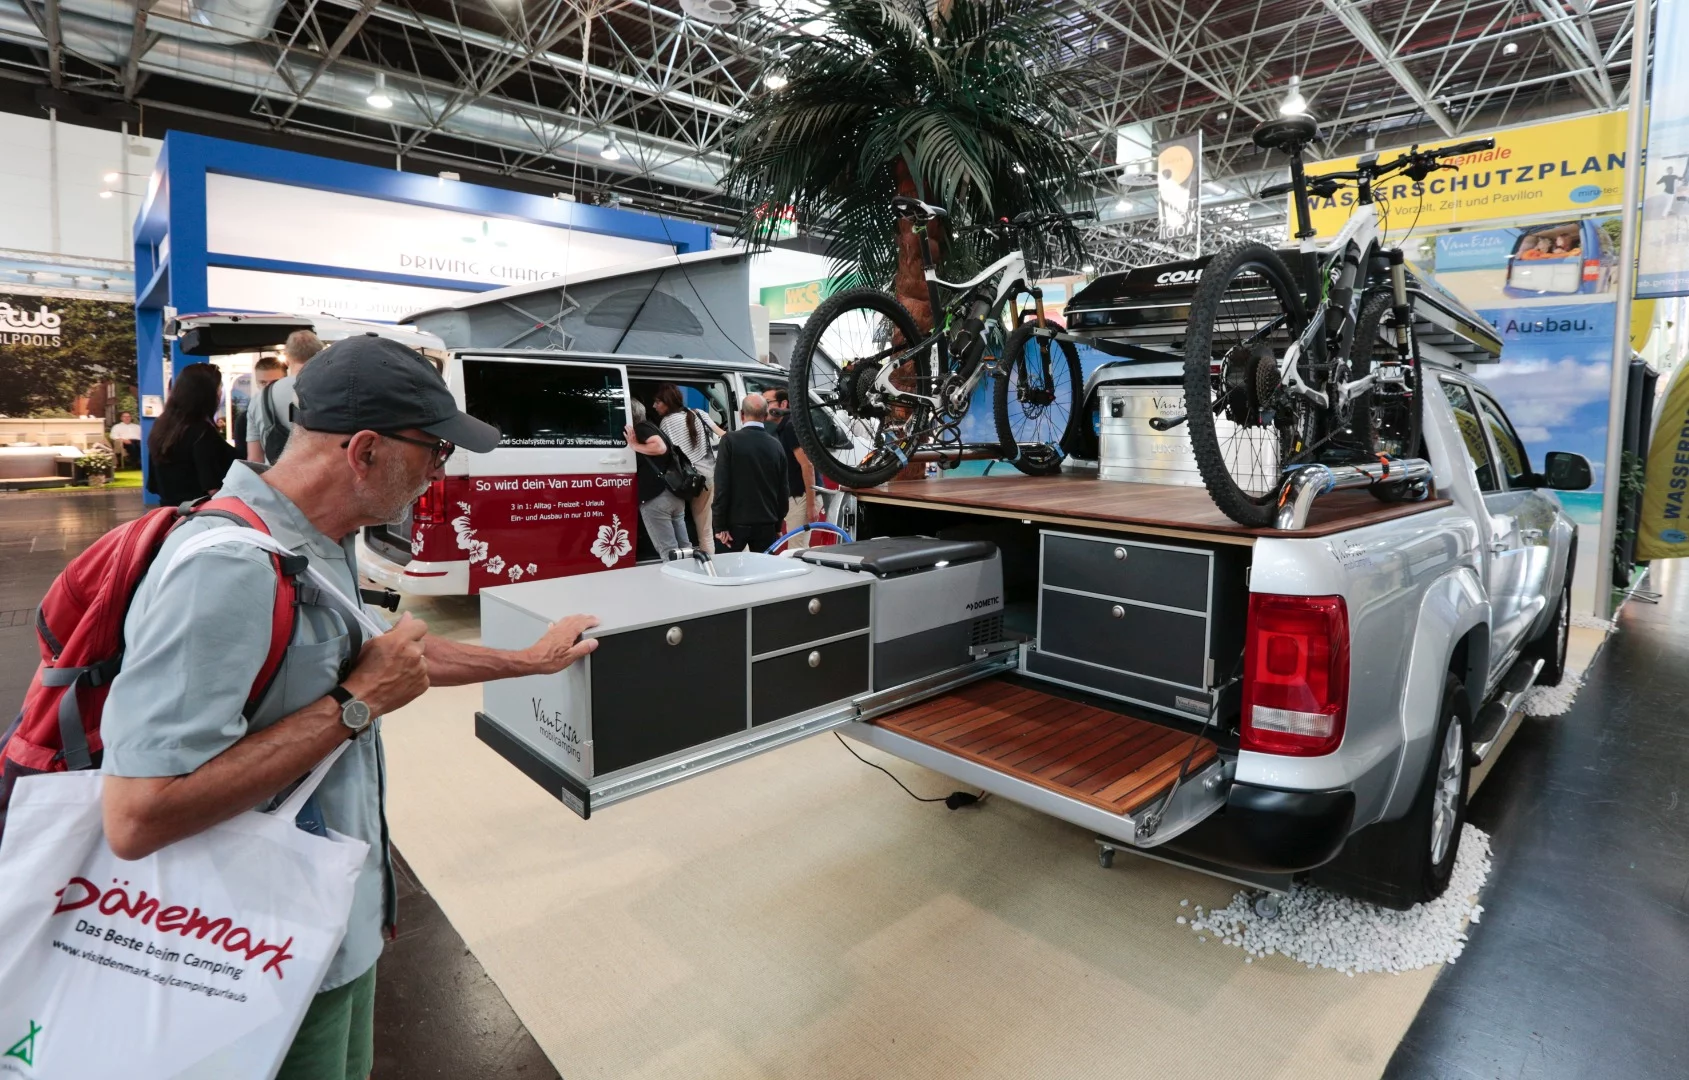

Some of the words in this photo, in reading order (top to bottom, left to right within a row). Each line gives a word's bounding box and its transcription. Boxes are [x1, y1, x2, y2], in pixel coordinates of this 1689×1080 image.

[1442, 146, 1511, 172] geniale
[1306, 148, 1647, 211] WASERSCHUTZPLAN
[1439, 199, 1462, 210] Zelt
[1466, 196, 1489, 206] und
[1493, 189, 1543, 204] Pavillon
[400, 253, 479, 275] DRIVING
[1505, 317, 1594, 334] Ausbau.
[556, 437, 565, 445] für
[475, 479, 491, 491] So
[494, 479, 519, 491] wird
[522, 478, 545, 490] dein
[549, 479, 568, 489] Van
[571, 480, 593, 488] zum
[595, 477, 633, 490] Camper
[510, 503, 516, 511] 3
[525, 502, 532, 510] 1:
[533, 502, 552, 510] Alltag
[510, 514, 524, 522] Ein-
[525, 513, 538, 521] und
[592, 510, 605, 518] Min.
[973, 596, 1000, 610] DOMETIC
[532, 697, 581, 745] VanEssa
[540, 726, 581, 762] mobilcamping
[53, 876, 294, 980] Dänemark
[75, 919, 102, 938] Das
[104, 927, 143, 951] Beste
[146, 941, 180, 963] beim
[184, 953, 244, 981] Camping
[52, 938, 249, 1003] www.visitdenmark.de/campingurlaub
